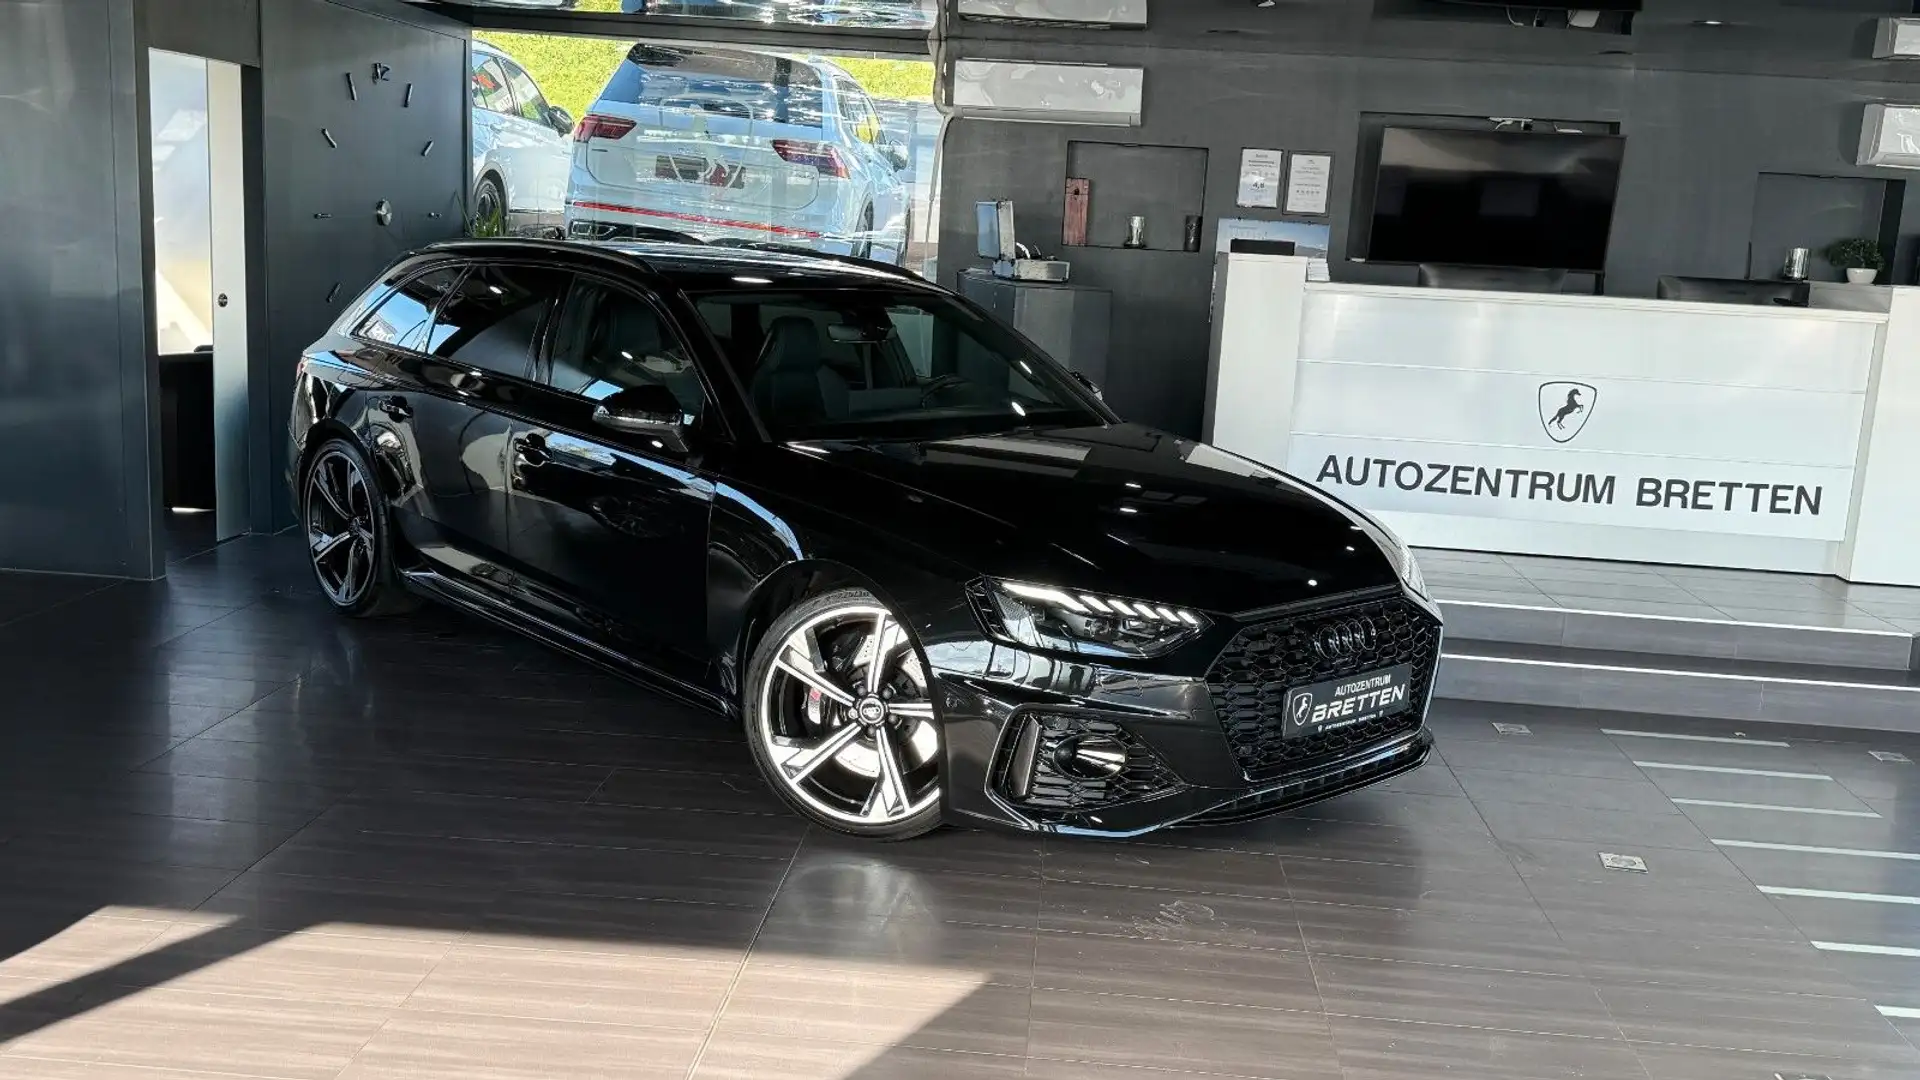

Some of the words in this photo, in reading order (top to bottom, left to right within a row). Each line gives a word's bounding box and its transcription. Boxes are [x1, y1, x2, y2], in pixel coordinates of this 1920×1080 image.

[1315, 454, 1616, 505] AUTOZENTRUM
[1635, 477, 1822, 515] BRETTEN
[1311, 684, 1405, 723] BRETTEN
[1334, 674, 1392, 697] AUTOZENTRUM
